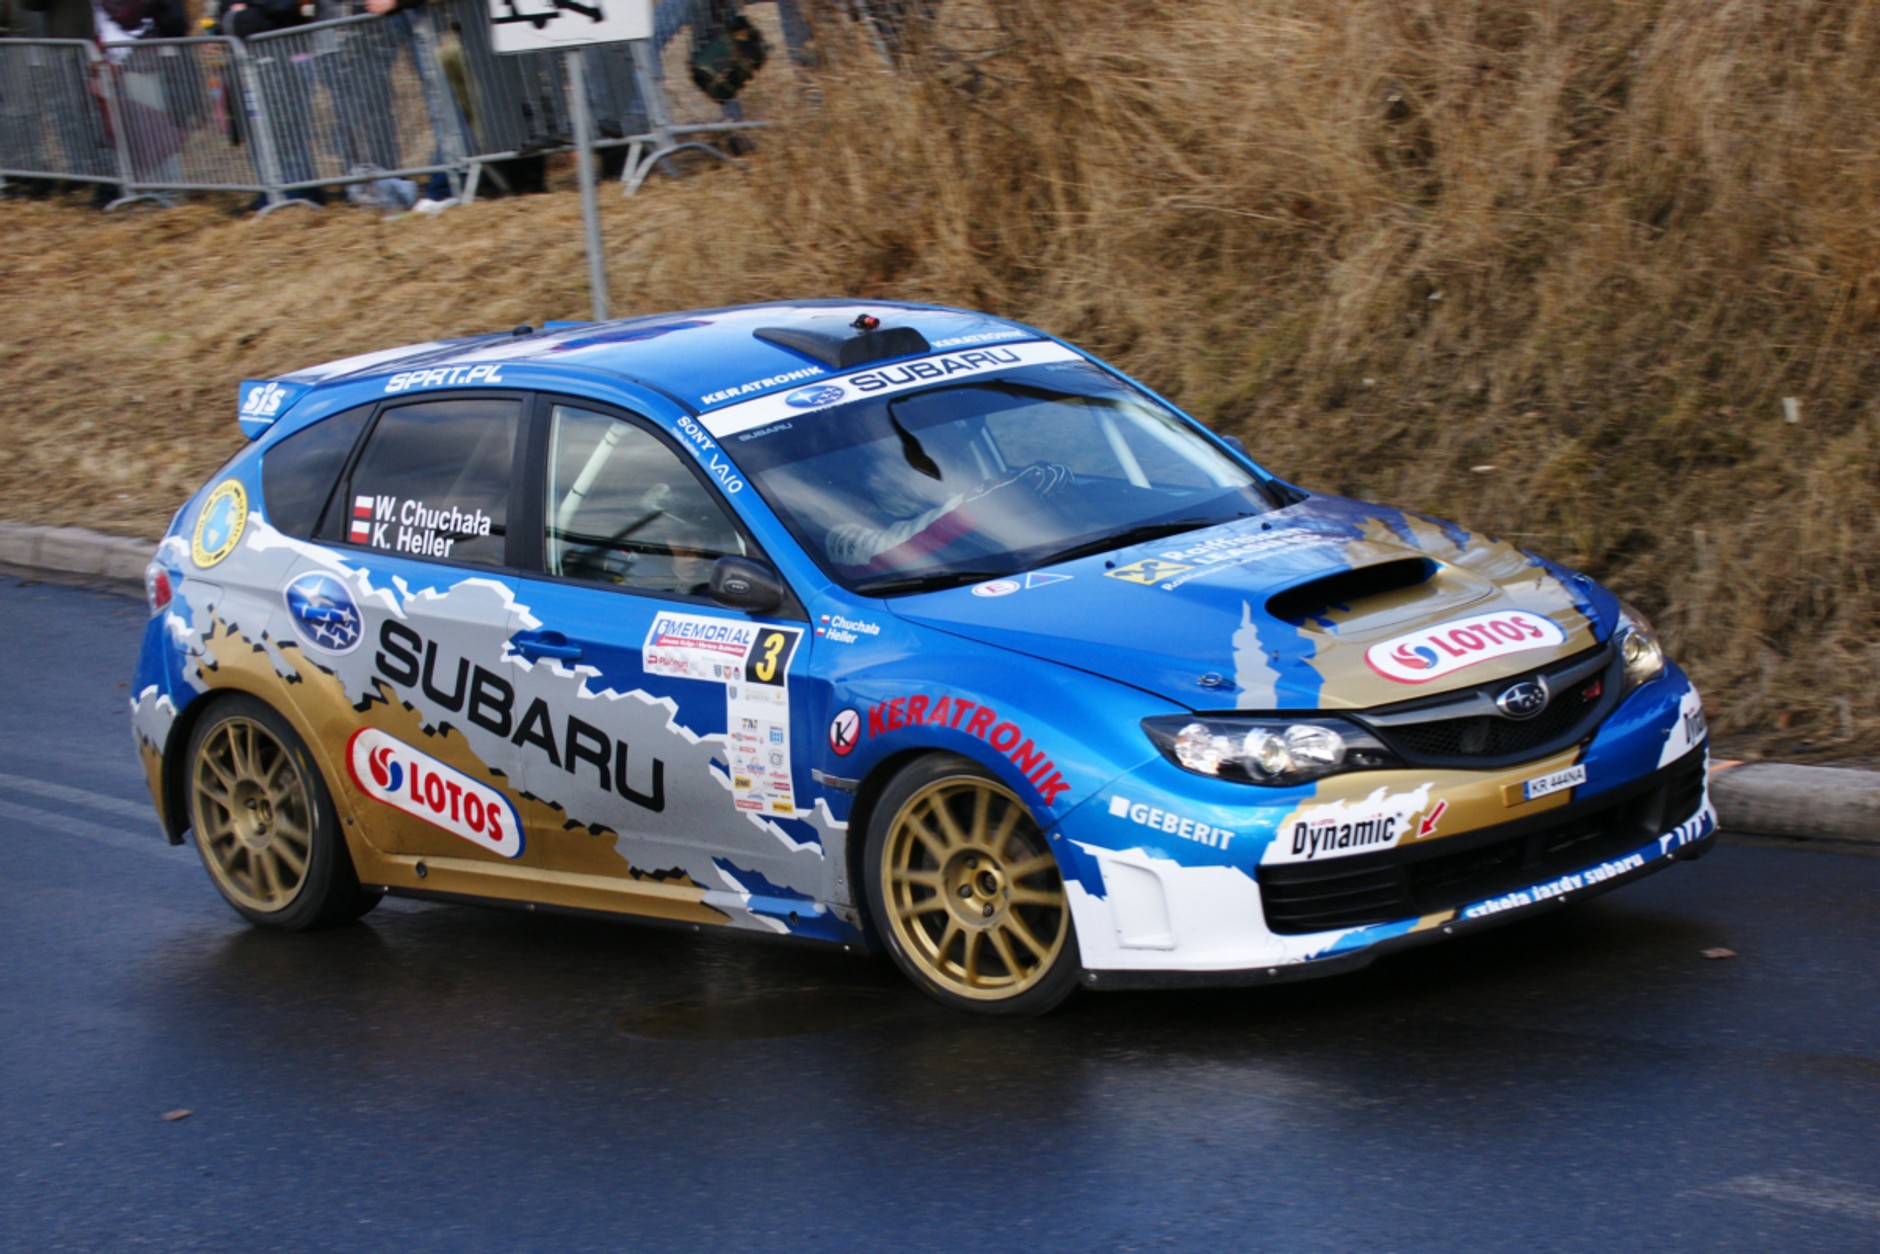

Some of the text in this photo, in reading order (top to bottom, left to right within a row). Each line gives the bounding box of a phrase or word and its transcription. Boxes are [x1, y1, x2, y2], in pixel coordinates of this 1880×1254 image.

[701, 365, 824, 405] KERATRONIK
[849, 348, 1021, 392] SUBARU
[739, 422, 793, 441] SUBARU
[677, 416, 716, 450] SONY
[709, 453, 743, 493] VAIO
[375, 495, 491, 536] W. Chuchała
[372, 522, 454, 558] K. Heller
[825, 628, 858, 644] Heller
[1428, 616, 1544, 657] LOTOS
[755, 633, 785, 682] 3
[375, 619, 665, 813] SUBARU
[834, 712, 857, 747] K
[867, 694, 1071, 806] KERATRONIK
[410, 761, 503, 842] LOTOS
[1531, 780, 1550, 794] KR
[1130, 803, 1235, 850] GEBERIT
[1291, 814, 1396, 859] Dynamic
[1583, 853, 1646, 885] subaru
